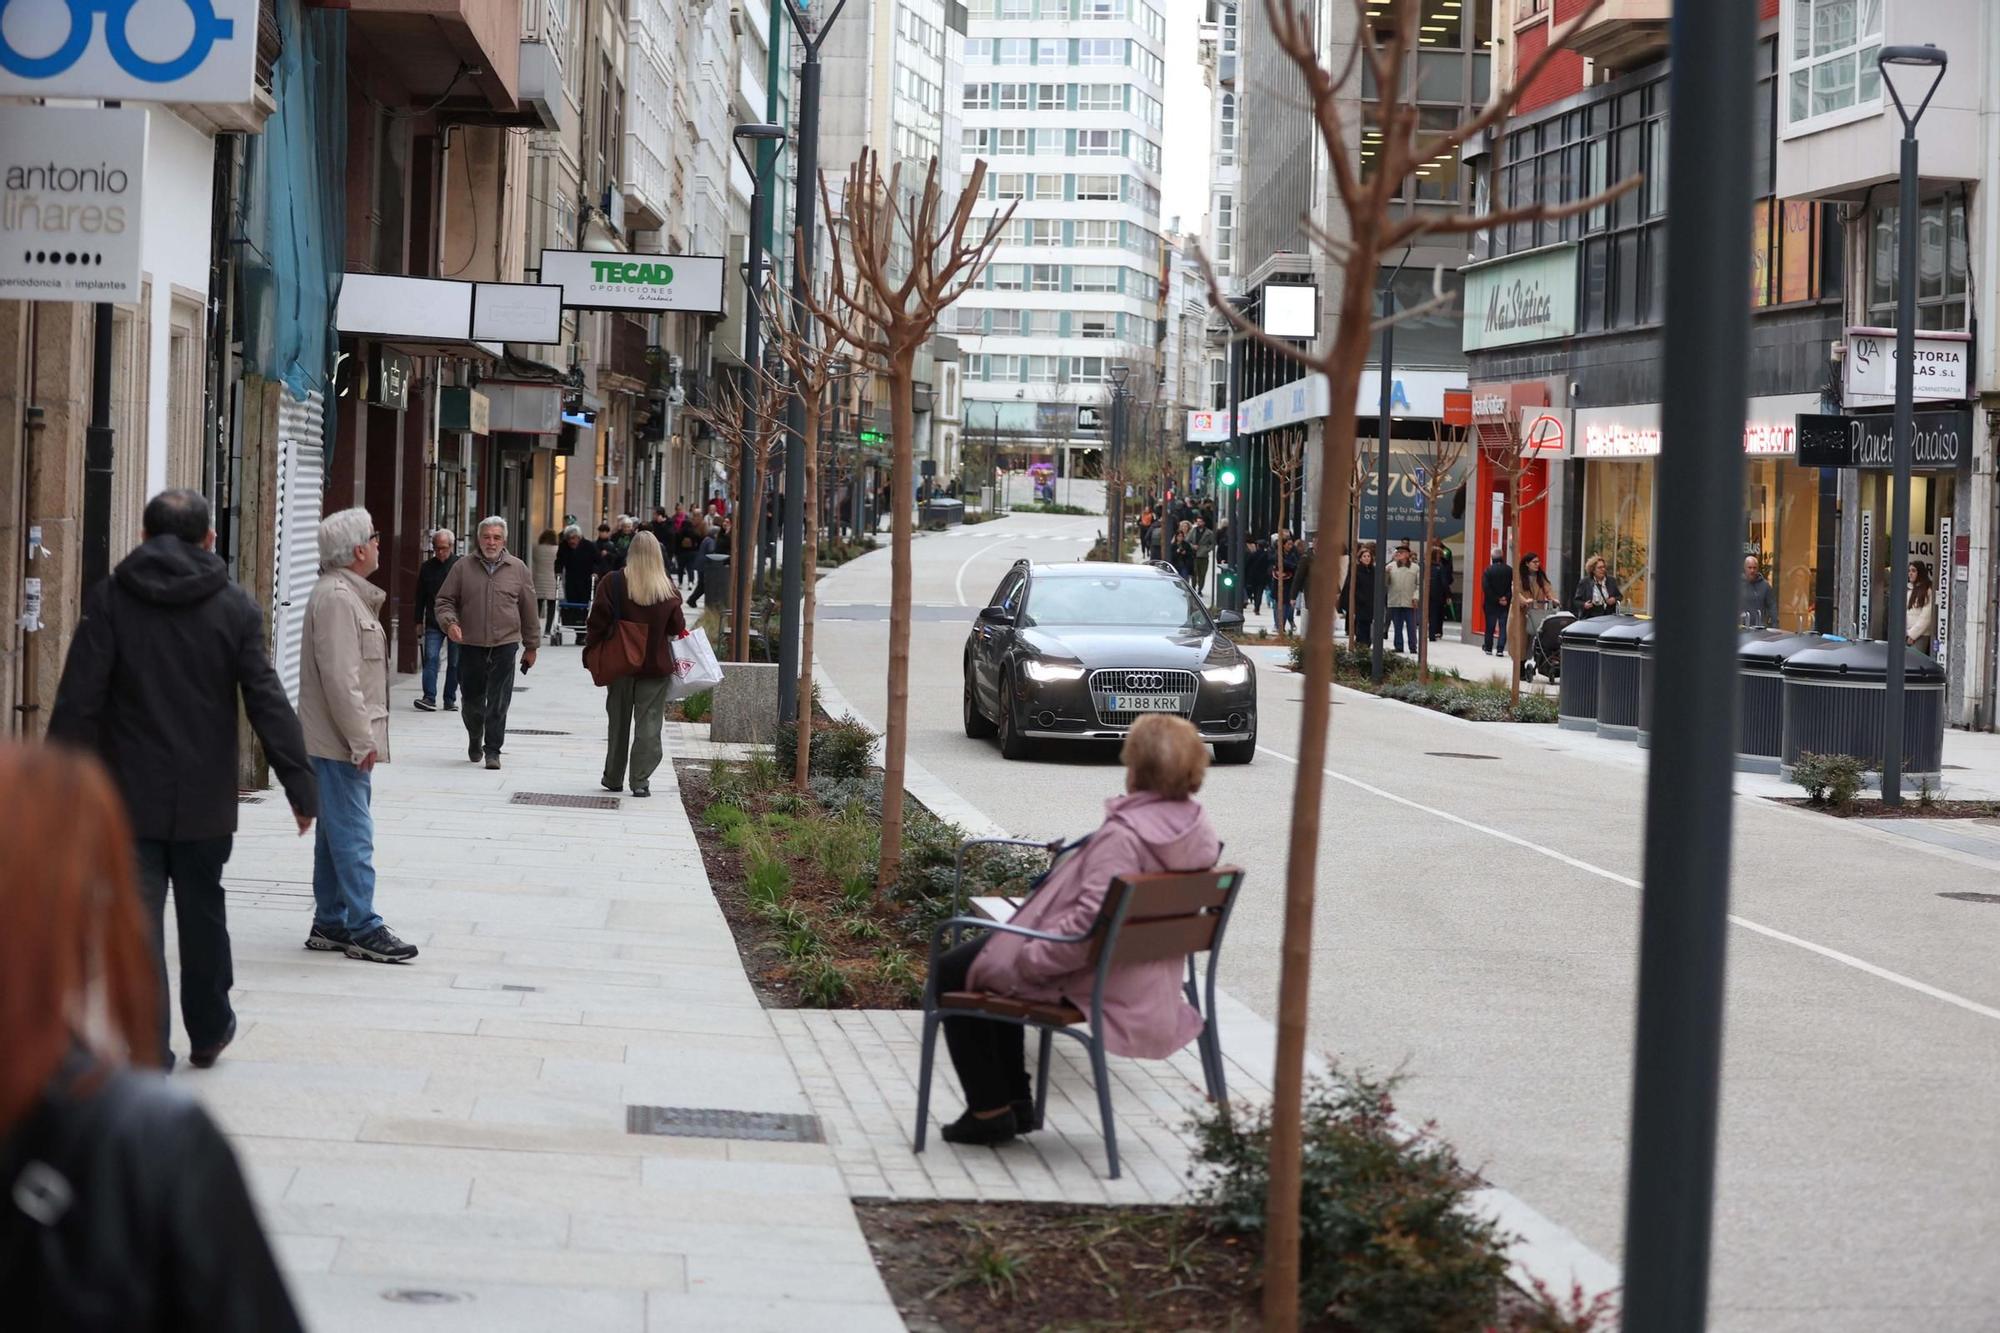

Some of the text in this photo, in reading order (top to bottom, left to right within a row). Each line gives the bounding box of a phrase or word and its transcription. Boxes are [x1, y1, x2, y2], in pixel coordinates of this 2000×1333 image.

[6, 160, 128, 194] antonio
[2, 191, 126, 234] liñares
[0, 277, 62, 288] periodoncia
[75, 278, 127, 290] implantes
[590, 285, 673, 294] OPOSICIONES
[591, 261, 674, 285] TECAD
[1850, 420, 1895, 463] Planet
[1861, 515, 1870, 598] LIQUIDACIÓN
[1940, 522, 1949, 610] LIQUIDACIÓN
[1118, 696, 1178, 710] 2188 KRK
